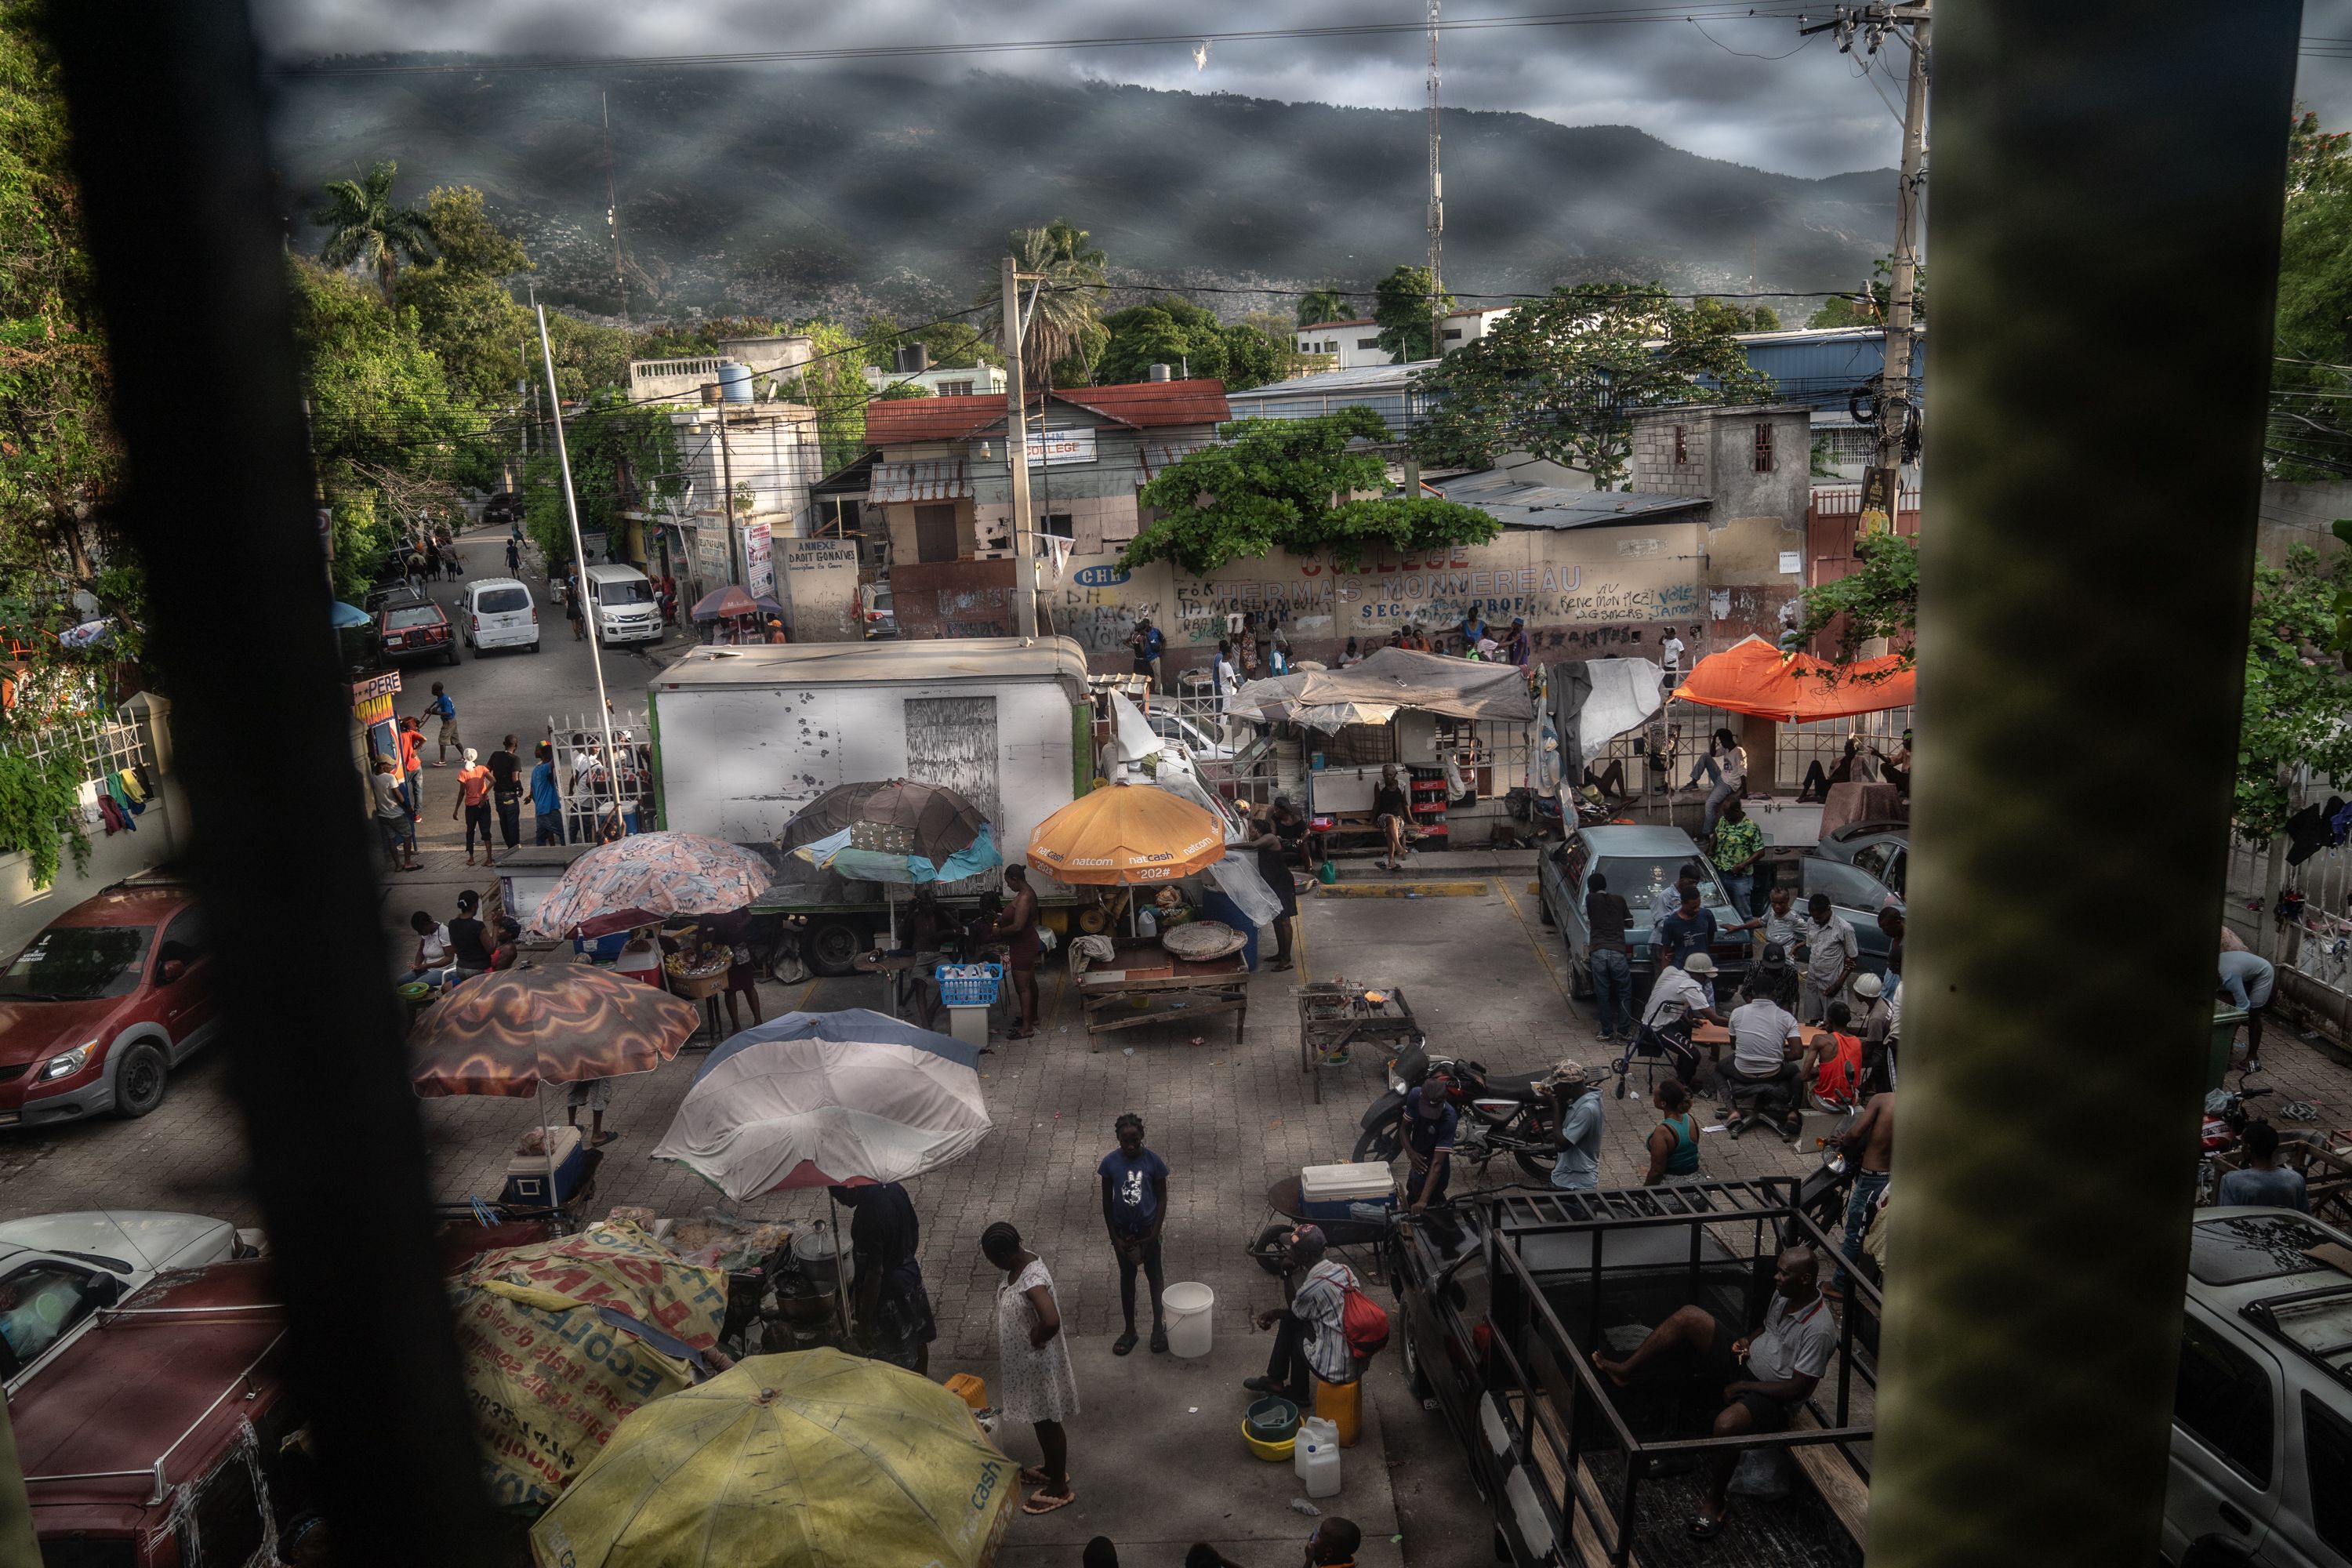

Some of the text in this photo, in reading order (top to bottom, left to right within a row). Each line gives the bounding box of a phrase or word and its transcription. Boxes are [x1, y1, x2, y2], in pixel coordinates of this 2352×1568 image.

[798, 541, 837, 551] ANNEXE
[789, 550, 855, 563] DROIT GONAÏVES
[1082, 568, 1121, 583] CHM
[1217, 565, 1581, 608] HERMAS MONNEREAU
[1362, 603, 1410, 619] SEC.
[368, 672, 401, 698] PERE
[1182, 837, 1214, 856] natcom
[1036, 846, 1065, 863] natcash
[1072, 858, 1113, 866] natcom
[1128, 851, 1174, 865] natcash
